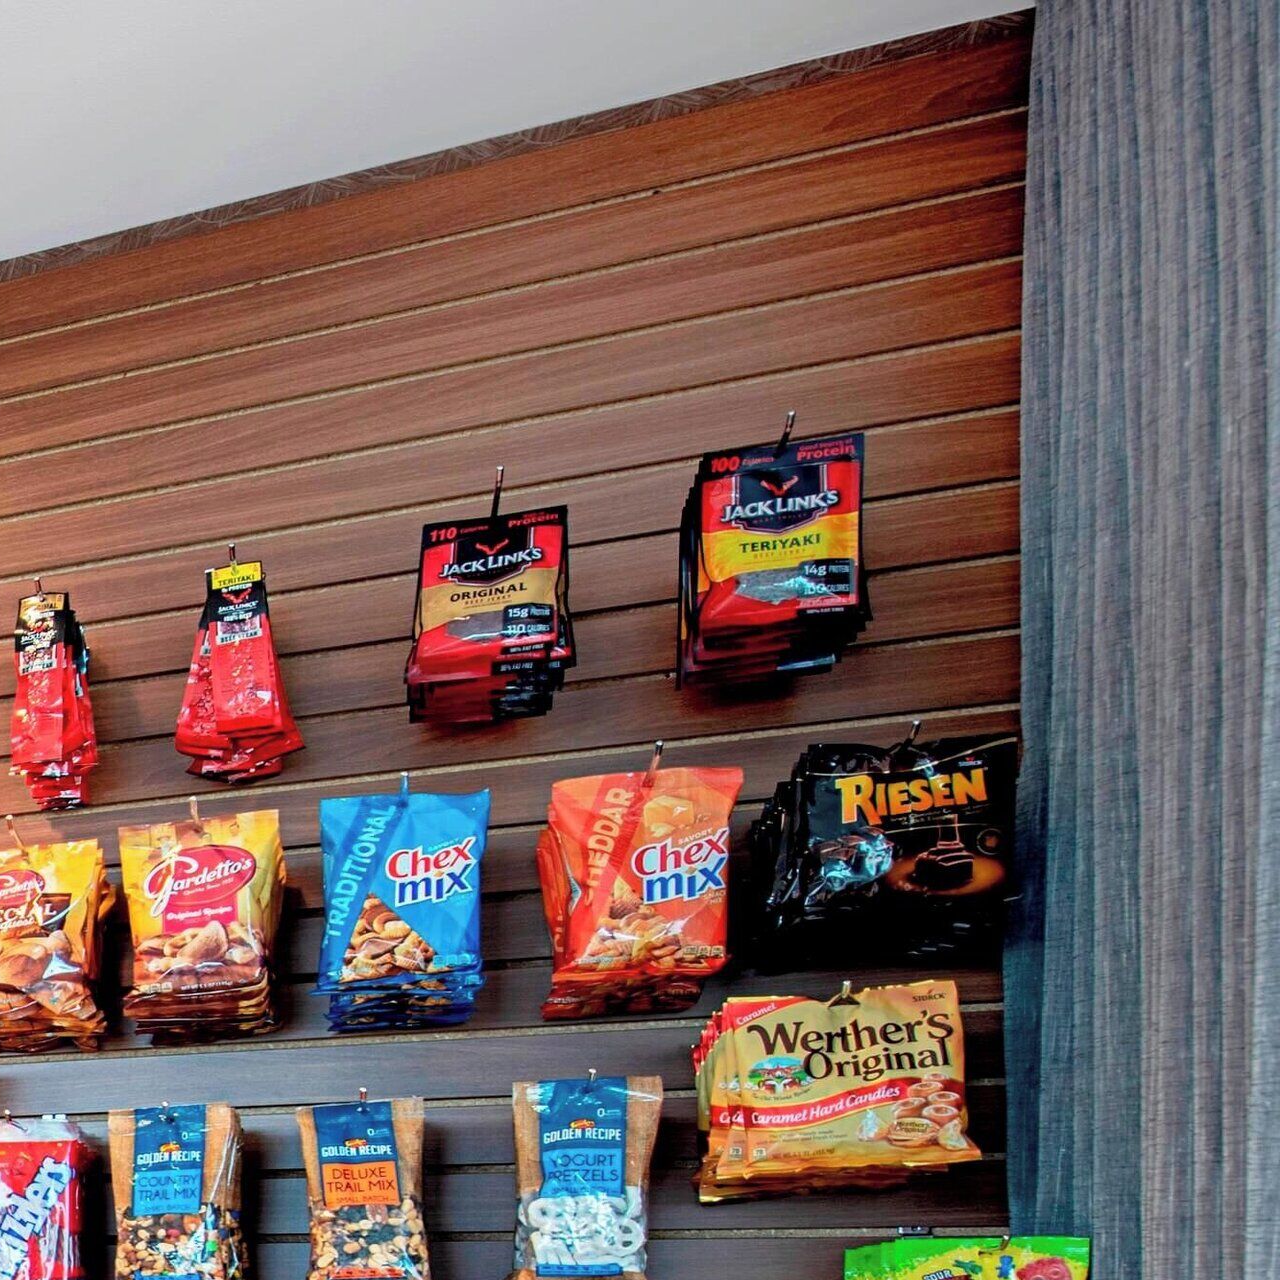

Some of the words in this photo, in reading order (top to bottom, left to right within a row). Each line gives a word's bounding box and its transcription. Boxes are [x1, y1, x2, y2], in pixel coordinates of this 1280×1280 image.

[797, 444, 857, 461] Protein
[711, 456, 739, 473] 100
[720, 500, 776, 522] JACK
[776, 490, 839, 513] LINK'S
[508, 512, 559, 528] Protein
[429, 527, 457, 542] 110
[740, 533, 821, 553] TERIYAKI
[438, 558, 487, 578] JACK
[487, 547, 543, 569] LINK'S
[804, 565, 827, 576] 14g
[217, 574, 255, 586] TERIYAKI
[450, 582, 528, 603] ORIGINAL
[835, 767, 988, 826] RIESEN
[678, 829, 713, 845] SAVORY
[387, 837, 475, 879] Chex
[634, 829, 729, 874] Chex
[328, 805, 397, 937] TRADITIONAL
[143, 855, 252, 918] Gardetto's
[397, 867, 472, 905] mix
[643, 858, 726, 904] mix
[166, 910, 202, 920] Original
[912, 992, 946, 1003] STORCK
[736, 1002, 777, 1026] Caramel
[747, 1009, 954, 1056] Werther's
[803, 1038, 951, 1082] Original
[751, 1109, 807, 1126] Caramel
[809, 1097, 846, 1121] Hard
[846, 1084, 900, 1109] Candies
[543, 1129, 583, 1144] GOLDEN
[584, 1128, 622, 1141] RECIPE
[137, 1151, 170, 1166] GOLDEN
[171, 1150, 202, 1163] RECIPE
[321, 1144, 357, 1158] GOLDEN
[358, 1143, 392, 1156] RECIPE
[549, 1153, 615, 1169] YOGURT
[140, 1174, 198, 1188] COUNTRY
[332, 1166, 388, 1181] DELUXE
[548, 1168, 619, 1184] PRETZELS
[141, 1187, 172, 1200] TRAIL
[173, 1187, 198, 1200] MIX
[326, 1180, 365, 1194] TRAIL
[368, 1178, 396, 1192] MIX
